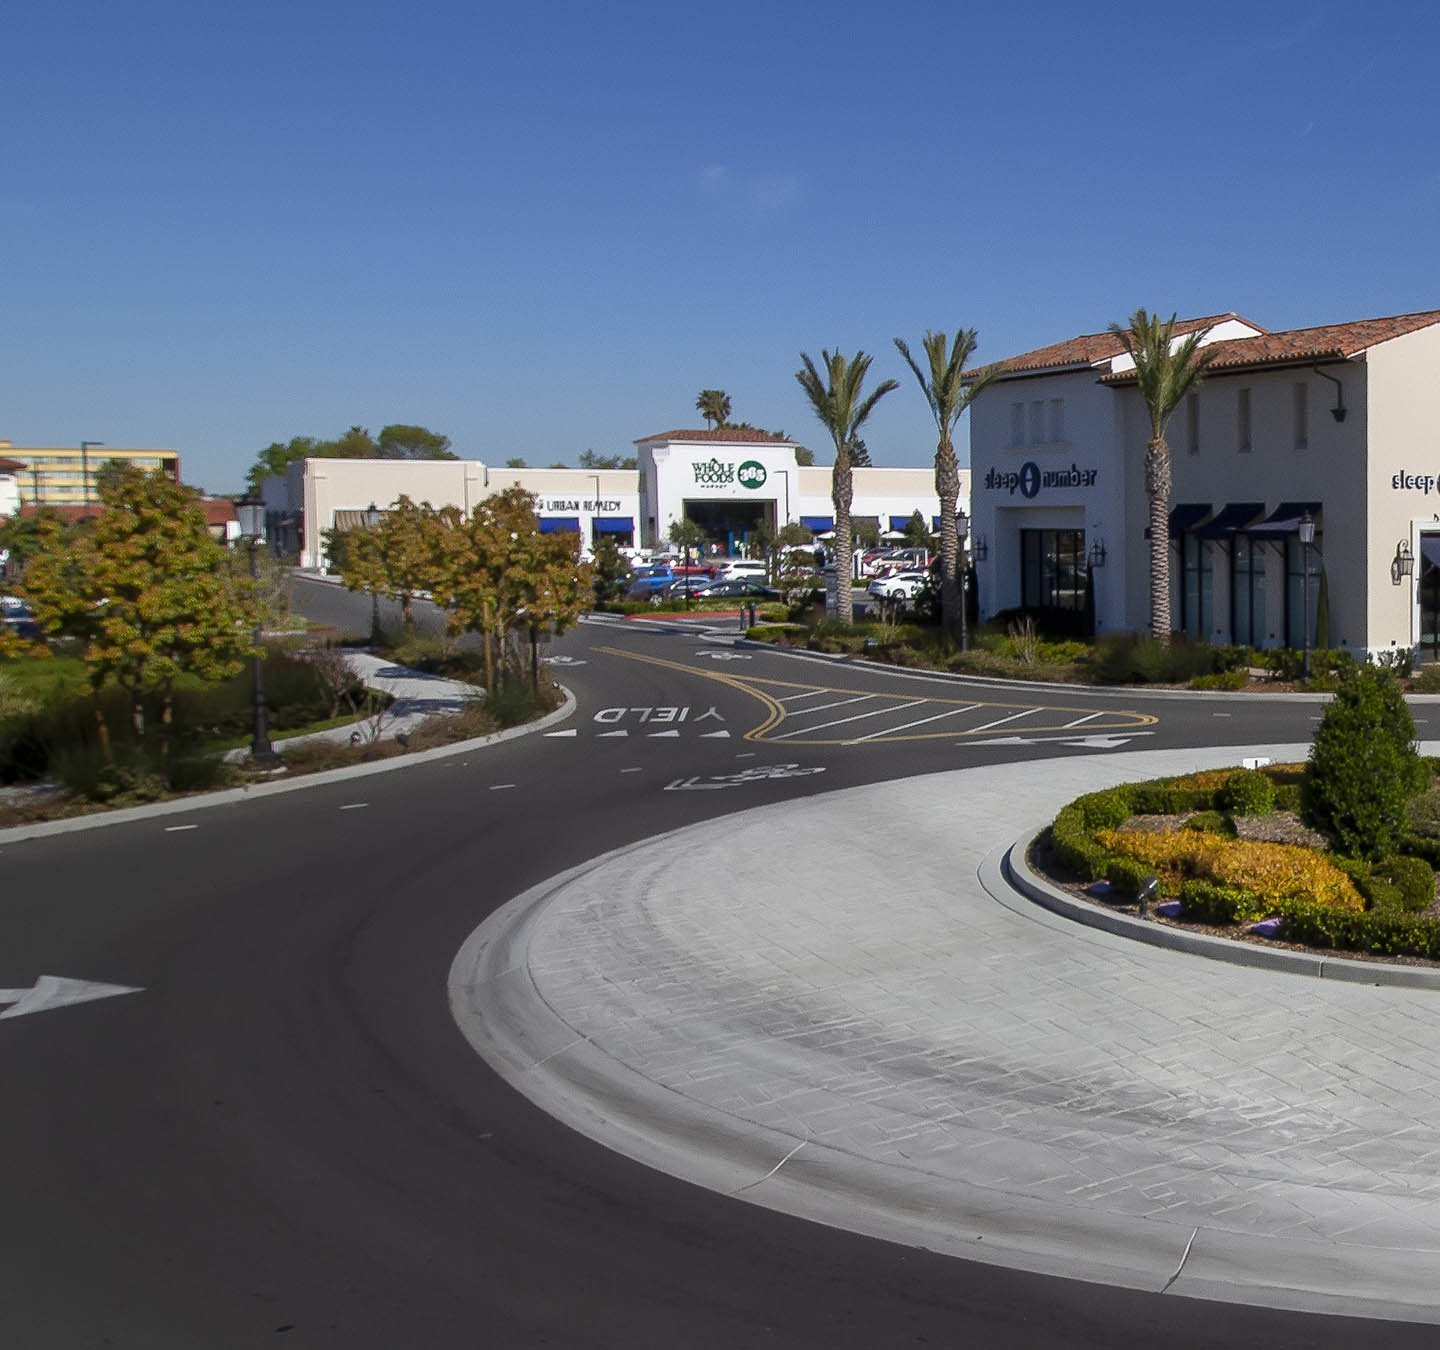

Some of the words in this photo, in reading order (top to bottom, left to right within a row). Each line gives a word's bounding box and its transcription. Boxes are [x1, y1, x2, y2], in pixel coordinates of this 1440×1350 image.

[692, 457, 735, 472] WHOLE
[695, 470, 735, 483] FOODS
[984, 466, 1019, 496] sleep
[1042, 463, 1098, 488] number
[1391, 469, 1434, 496] sleep
[546, 500, 579, 511] URBAN
[583, 500, 621, 512] REMEDY
[594, 706, 725, 723] YIELD
